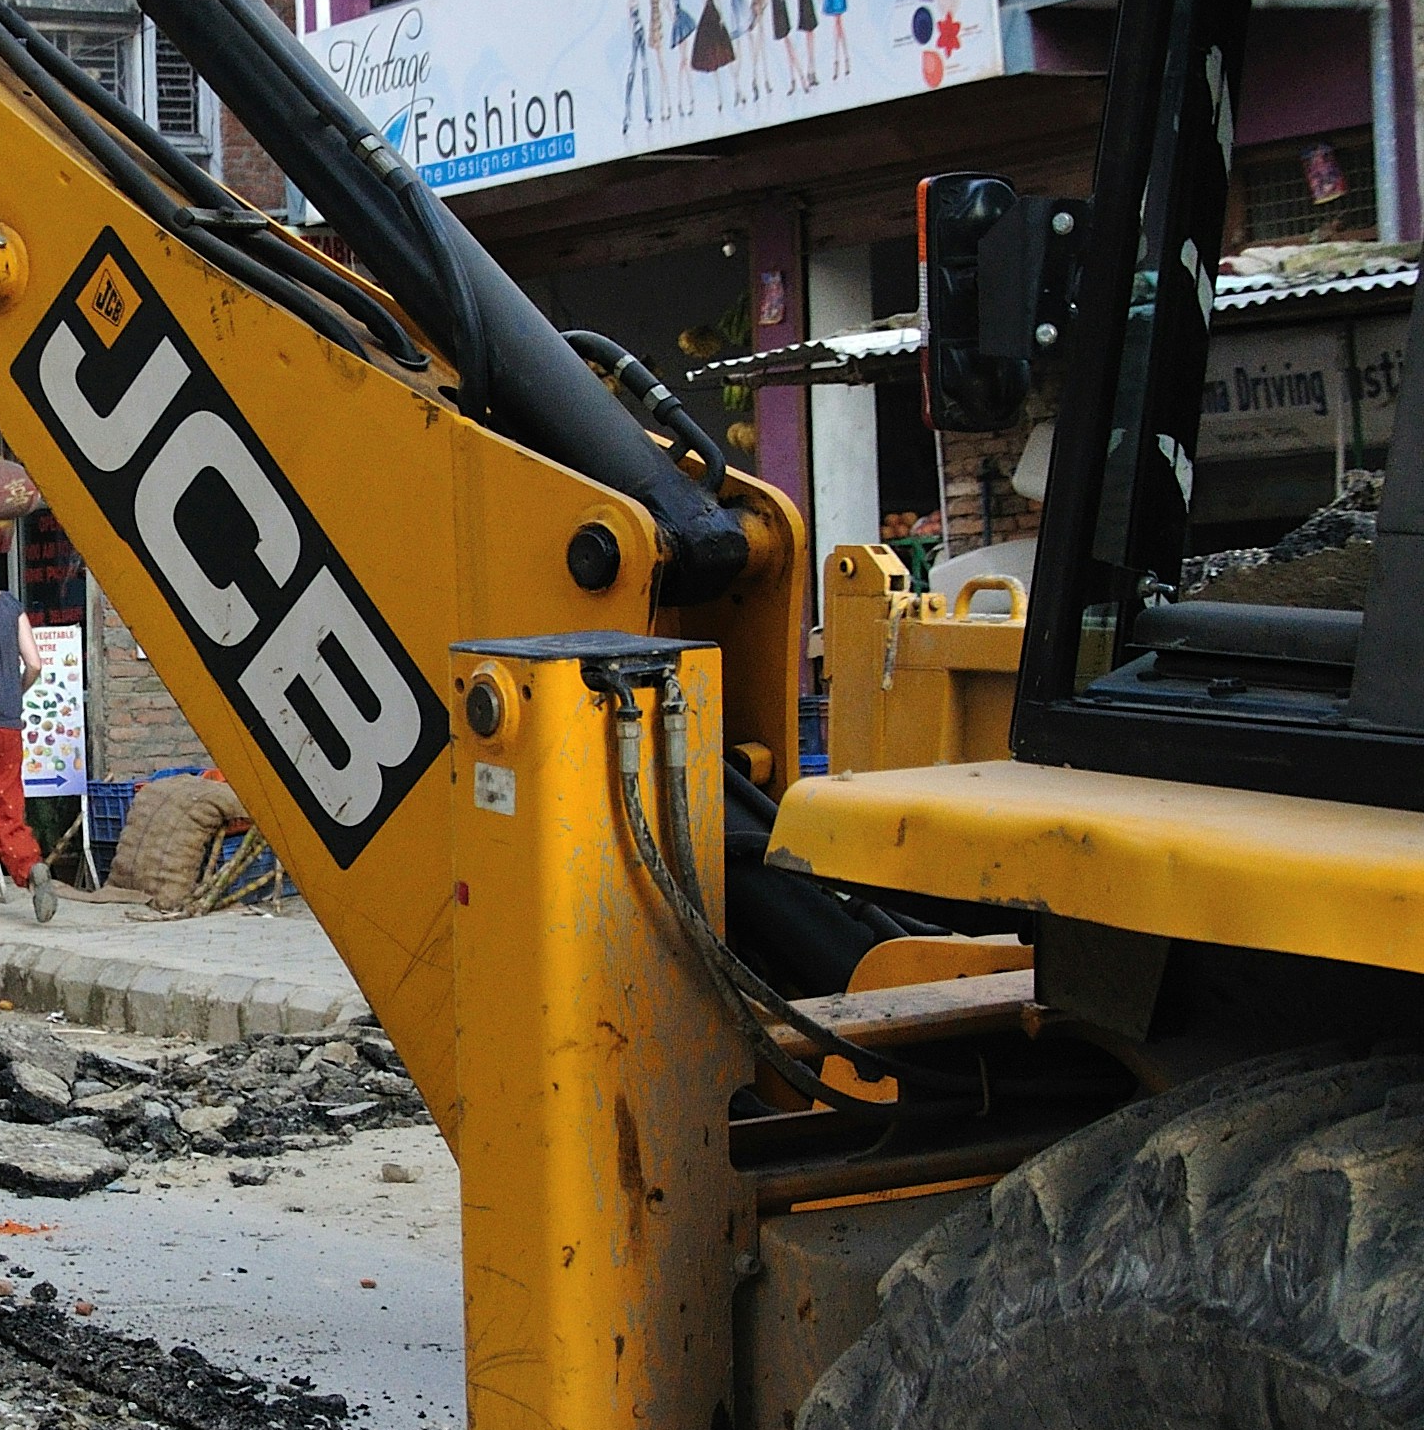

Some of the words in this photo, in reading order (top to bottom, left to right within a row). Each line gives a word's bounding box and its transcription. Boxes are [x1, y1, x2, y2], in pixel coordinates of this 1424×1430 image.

[329, 7, 432, 100] Vintage
[414, 88, 575, 164] Fashion
[447, 150, 518, 181] Designer
[521, 136, 575, 164] Studio
[94, 278, 123, 323] JCB
[1234, 362, 1328, 416] Driving
[39, 319, 422, 827] JCB
[35, 630, 74, 640] VEGETABLE
